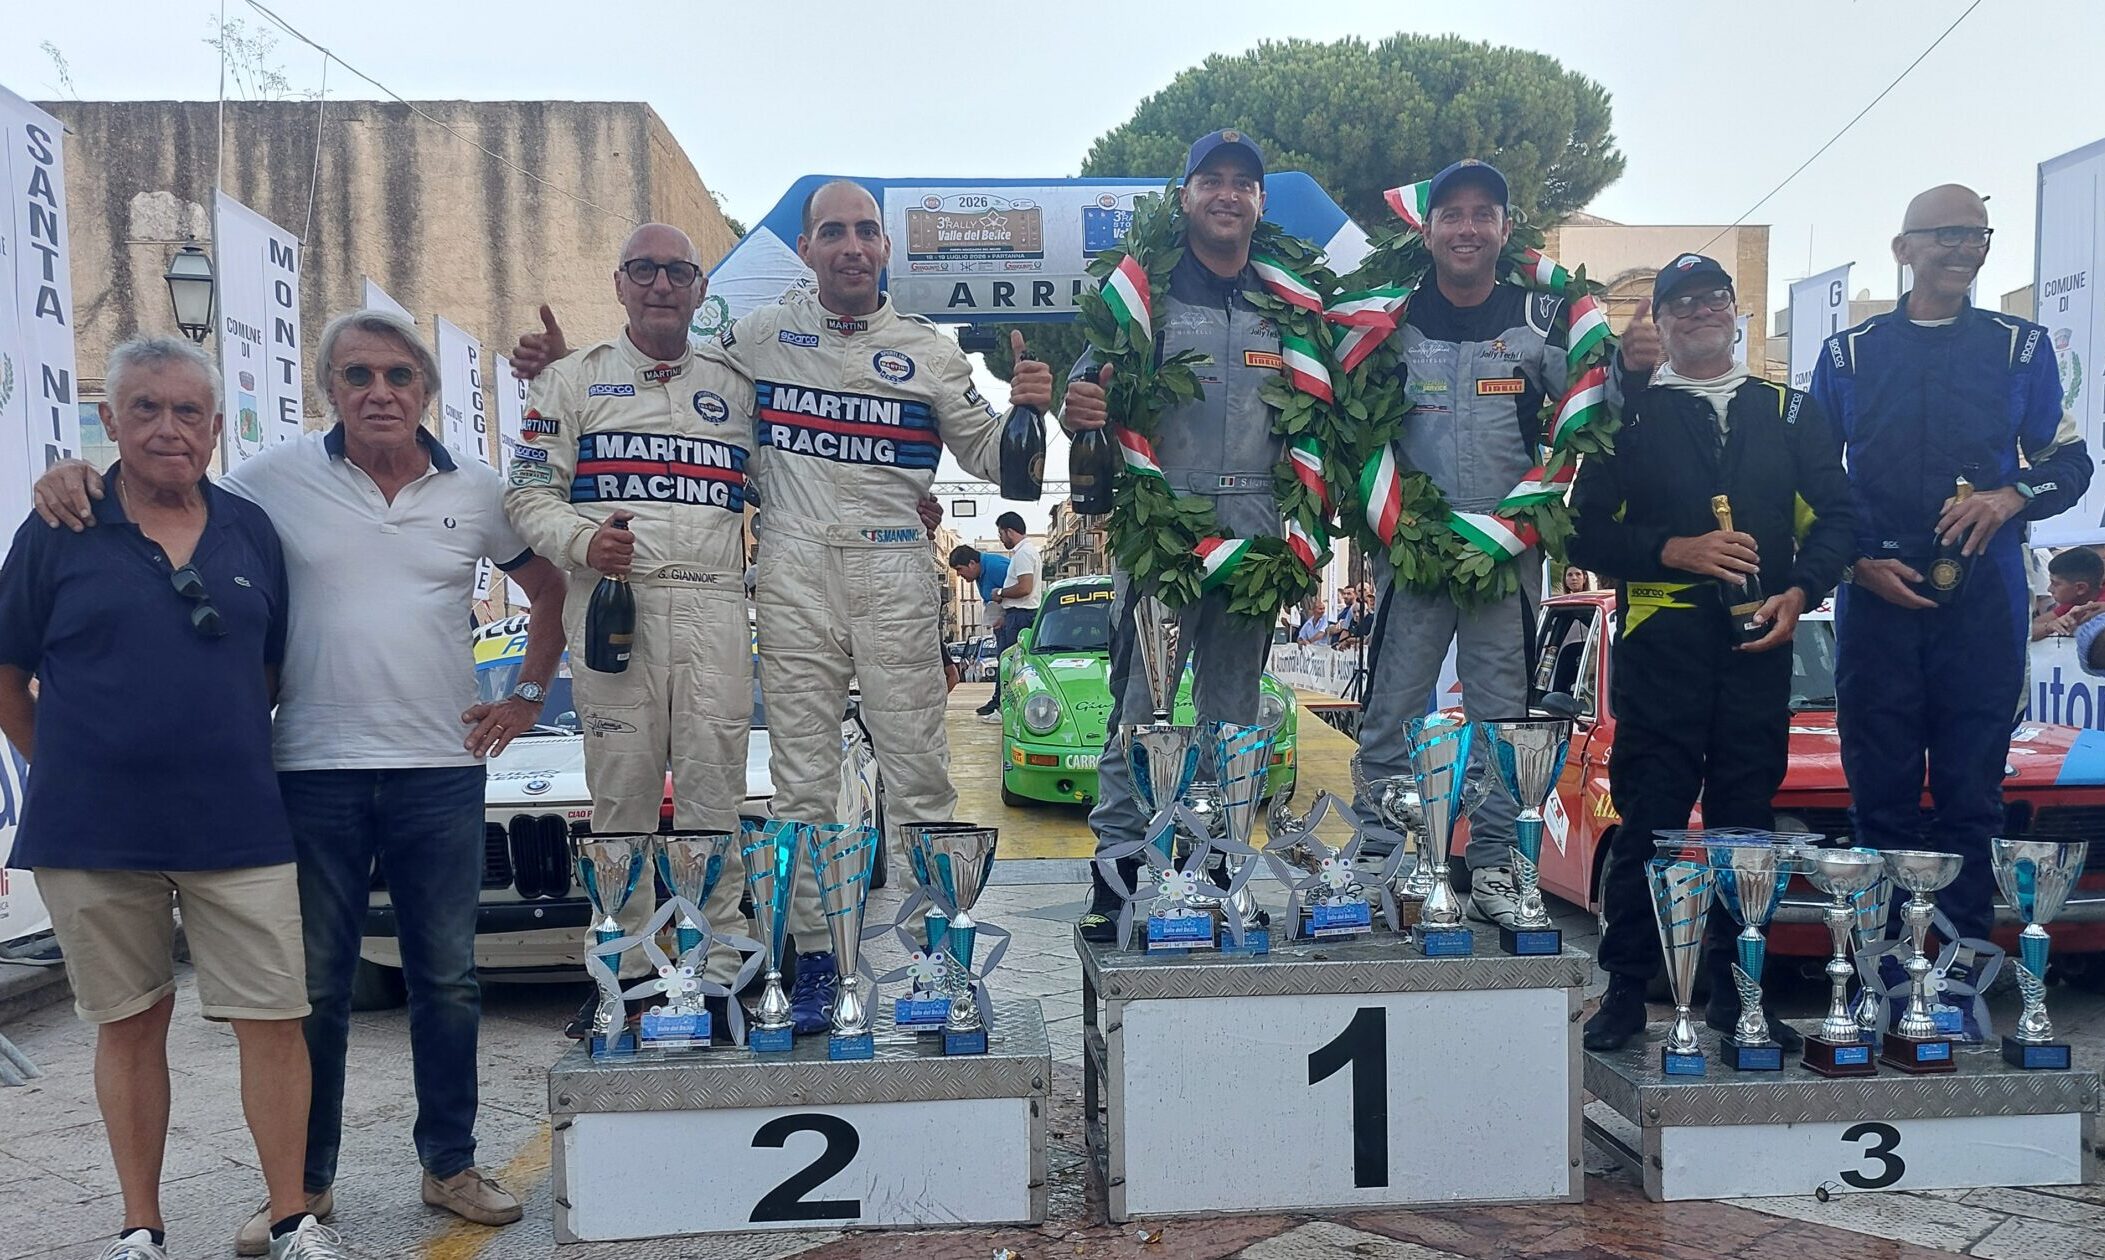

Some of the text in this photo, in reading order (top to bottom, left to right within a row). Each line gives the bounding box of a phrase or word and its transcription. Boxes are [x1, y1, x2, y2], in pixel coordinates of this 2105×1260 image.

[959, 196, 988, 208] 2026
[25, 123, 65, 327] SANTA
[938, 230, 962, 241] Valle
[964, 230, 980, 241] del
[946, 220, 977, 229] RALLY
[947, 280, 1104, 308] ARRI
[2043, 270, 2087, 299] COMUNE
[2058, 296, 2070, 313] DI
[226, 316, 263, 347] COMUNE
[269, 237, 299, 443] MONTE
[780, 331, 818, 345] sparco
[828, 320, 867, 331] MARTINI
[241, 341, 251, 359] DI
[1828, 338, 1845, 368] sparco
[2019, 329, 2041, 364] sparco
[645, 365, 682, 381] MARTINI
[1481, 379, 1523, 393] PIRELLI
[589, 385, 633, 396] sparco
[468, 345, 489, 466] POGGI
[772, 386, 901, 426] MARTINI
[1786, 392, 1802, 424] sparco
[595, 434, 732, 469] MARTINI
[771, 424, 896, 463] RACING
[597, 473, 730, 507] RACING
[671, 569, 719, 584] GIANNONE
[1631, 588, 1664, 598] sparco
[568, 810, 586, 818] CIAO
[1307, 1006, 1389, 1188] 1
[748, 1112, 862, 1223] 2
[1839, 1121, 1907, 1190] 3
